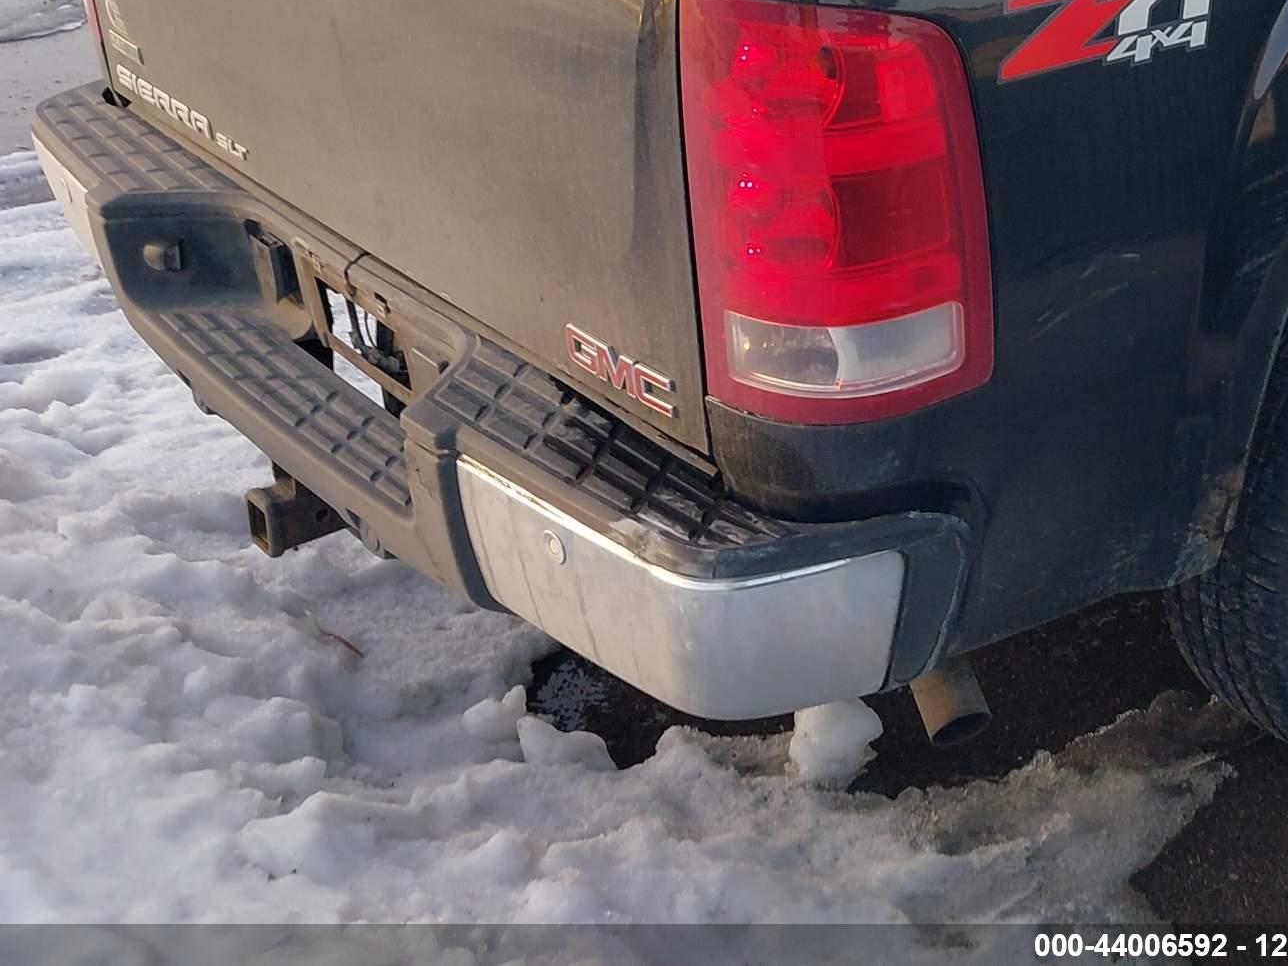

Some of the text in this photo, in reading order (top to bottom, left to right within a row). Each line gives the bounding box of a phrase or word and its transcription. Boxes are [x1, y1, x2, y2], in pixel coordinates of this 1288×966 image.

[116, 63, 250, 161] SIERRA SLT
[564, 323, 679, 419] GMC
